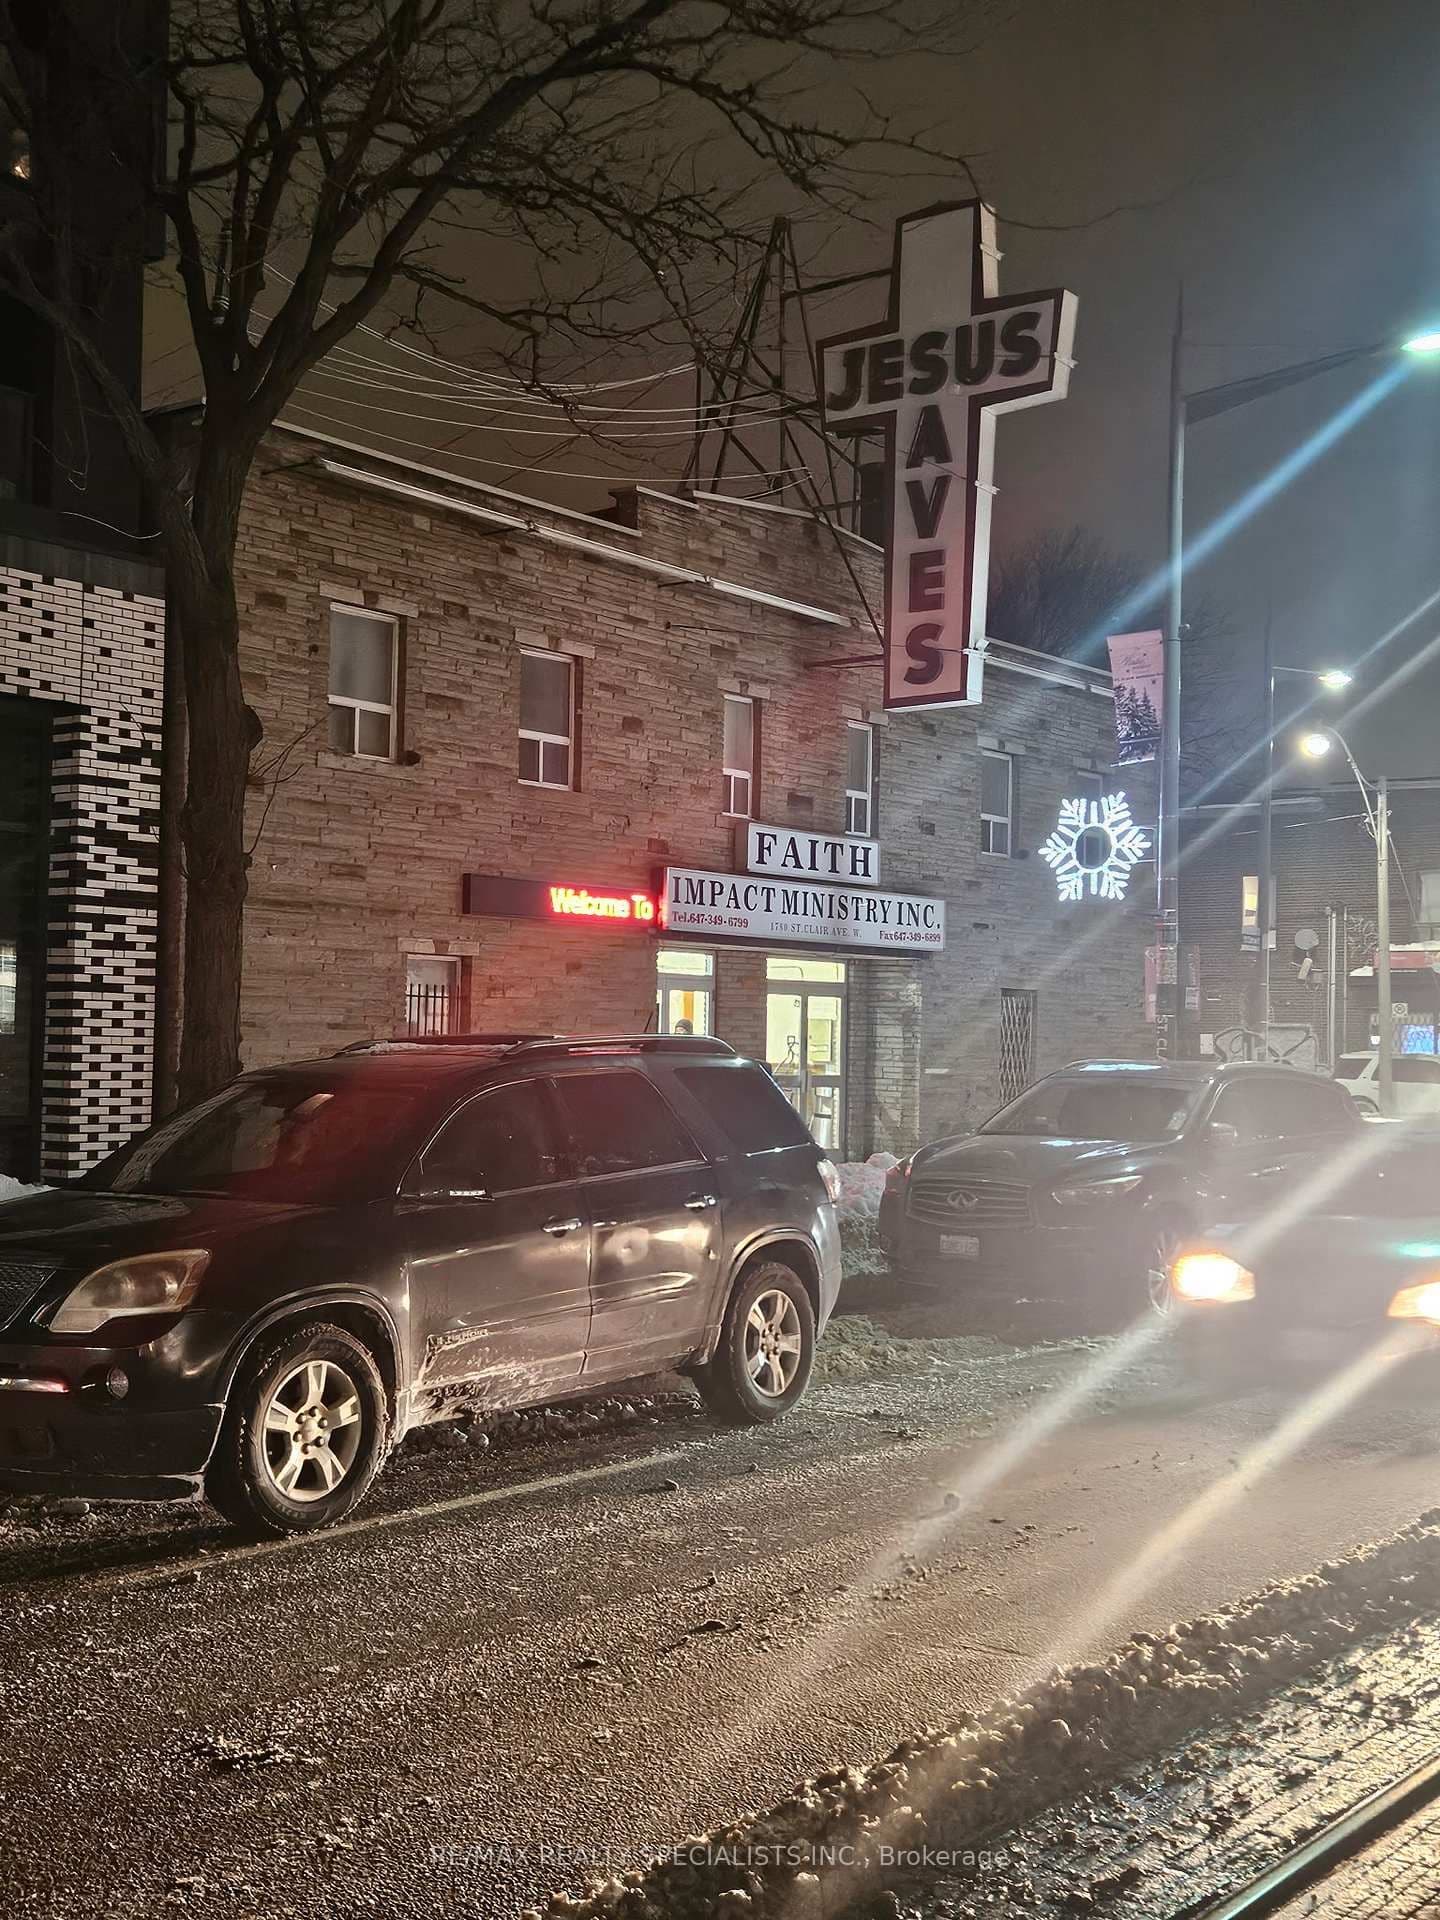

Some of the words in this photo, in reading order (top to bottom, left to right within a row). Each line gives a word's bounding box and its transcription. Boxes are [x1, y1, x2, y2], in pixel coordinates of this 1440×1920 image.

[826, 311, 1042, 412] JESUS
[755, 831, 872, 878] FAITH
[550, 887, 630, 918] Welcome
[630, 893, 654, 920] To
[672, 876, 776, 913] IMPACT
[781, 889, 892, 925] MINISTRY
[896, 901, 941, 930] INC.
